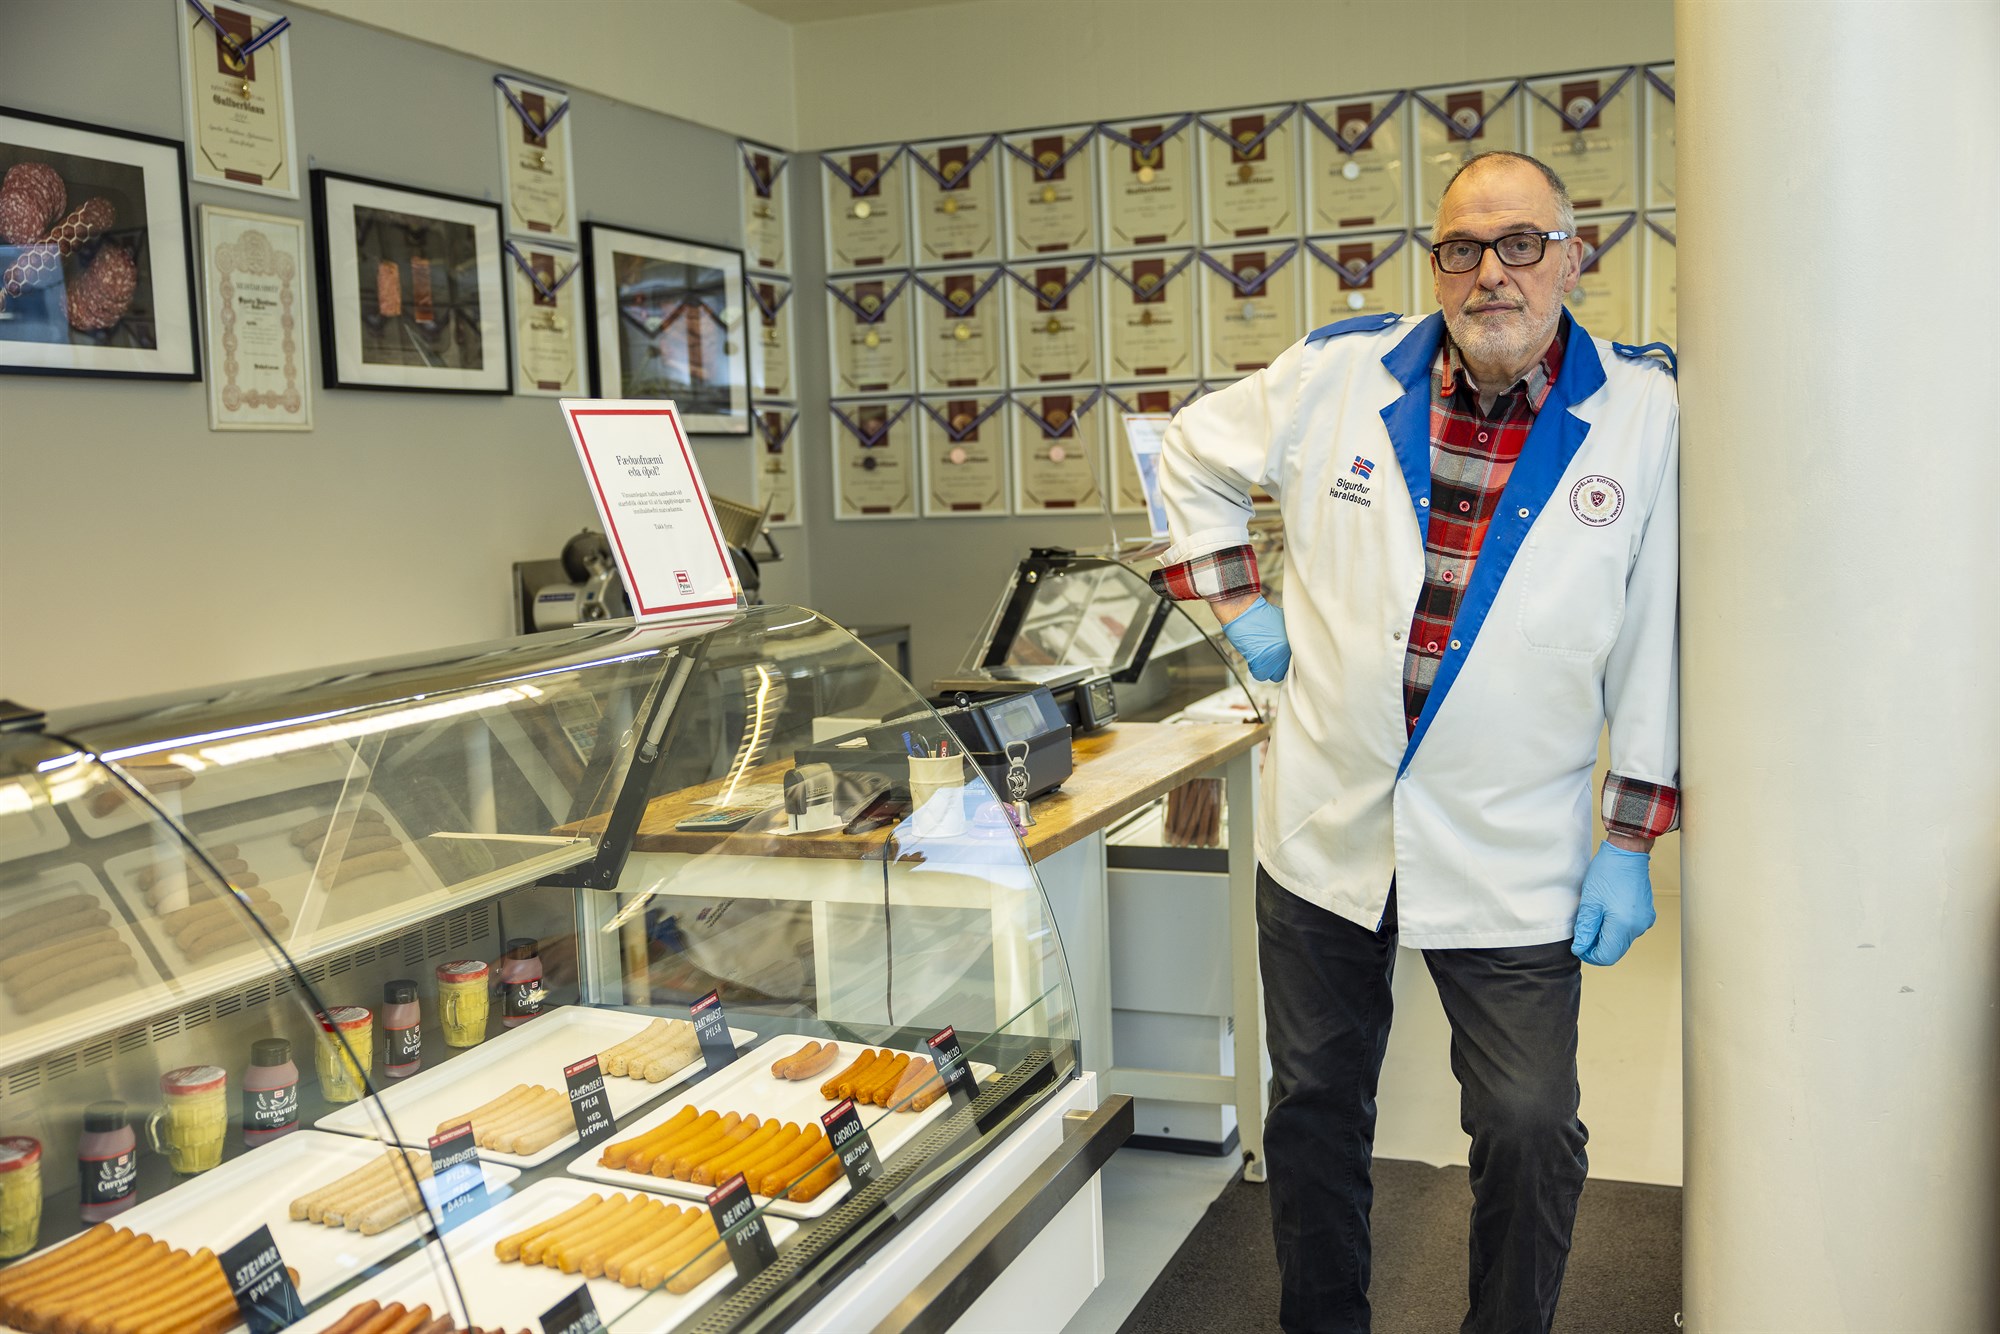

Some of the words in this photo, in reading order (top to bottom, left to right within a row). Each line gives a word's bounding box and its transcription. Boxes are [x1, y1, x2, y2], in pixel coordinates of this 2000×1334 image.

[1336, 478, 1370, 494] Sigurður
[1329, 487, 1371, 508] Haraldsson
[705, 1023, 722, 1040] PYLSA
[938, 1046, 960, 1066] CHORIZO
[569, 1076, 603, 1099] CAMEMBERT
[255, 1102, 298, 1121] Currywurst
[581, 1095, 599, 1112] PYLSA
[580, 1118, 609, 1138] SVEPPUM
[833, 1120, 860, 1146] CHORIZO
[446, 1193, 475, 1213] BASIL
[722, 1196, 752, 1228] BEIKON
[735, 1219, 761, 1246] PYLSA
[248, 1271, 283, 1304] PYLSA
